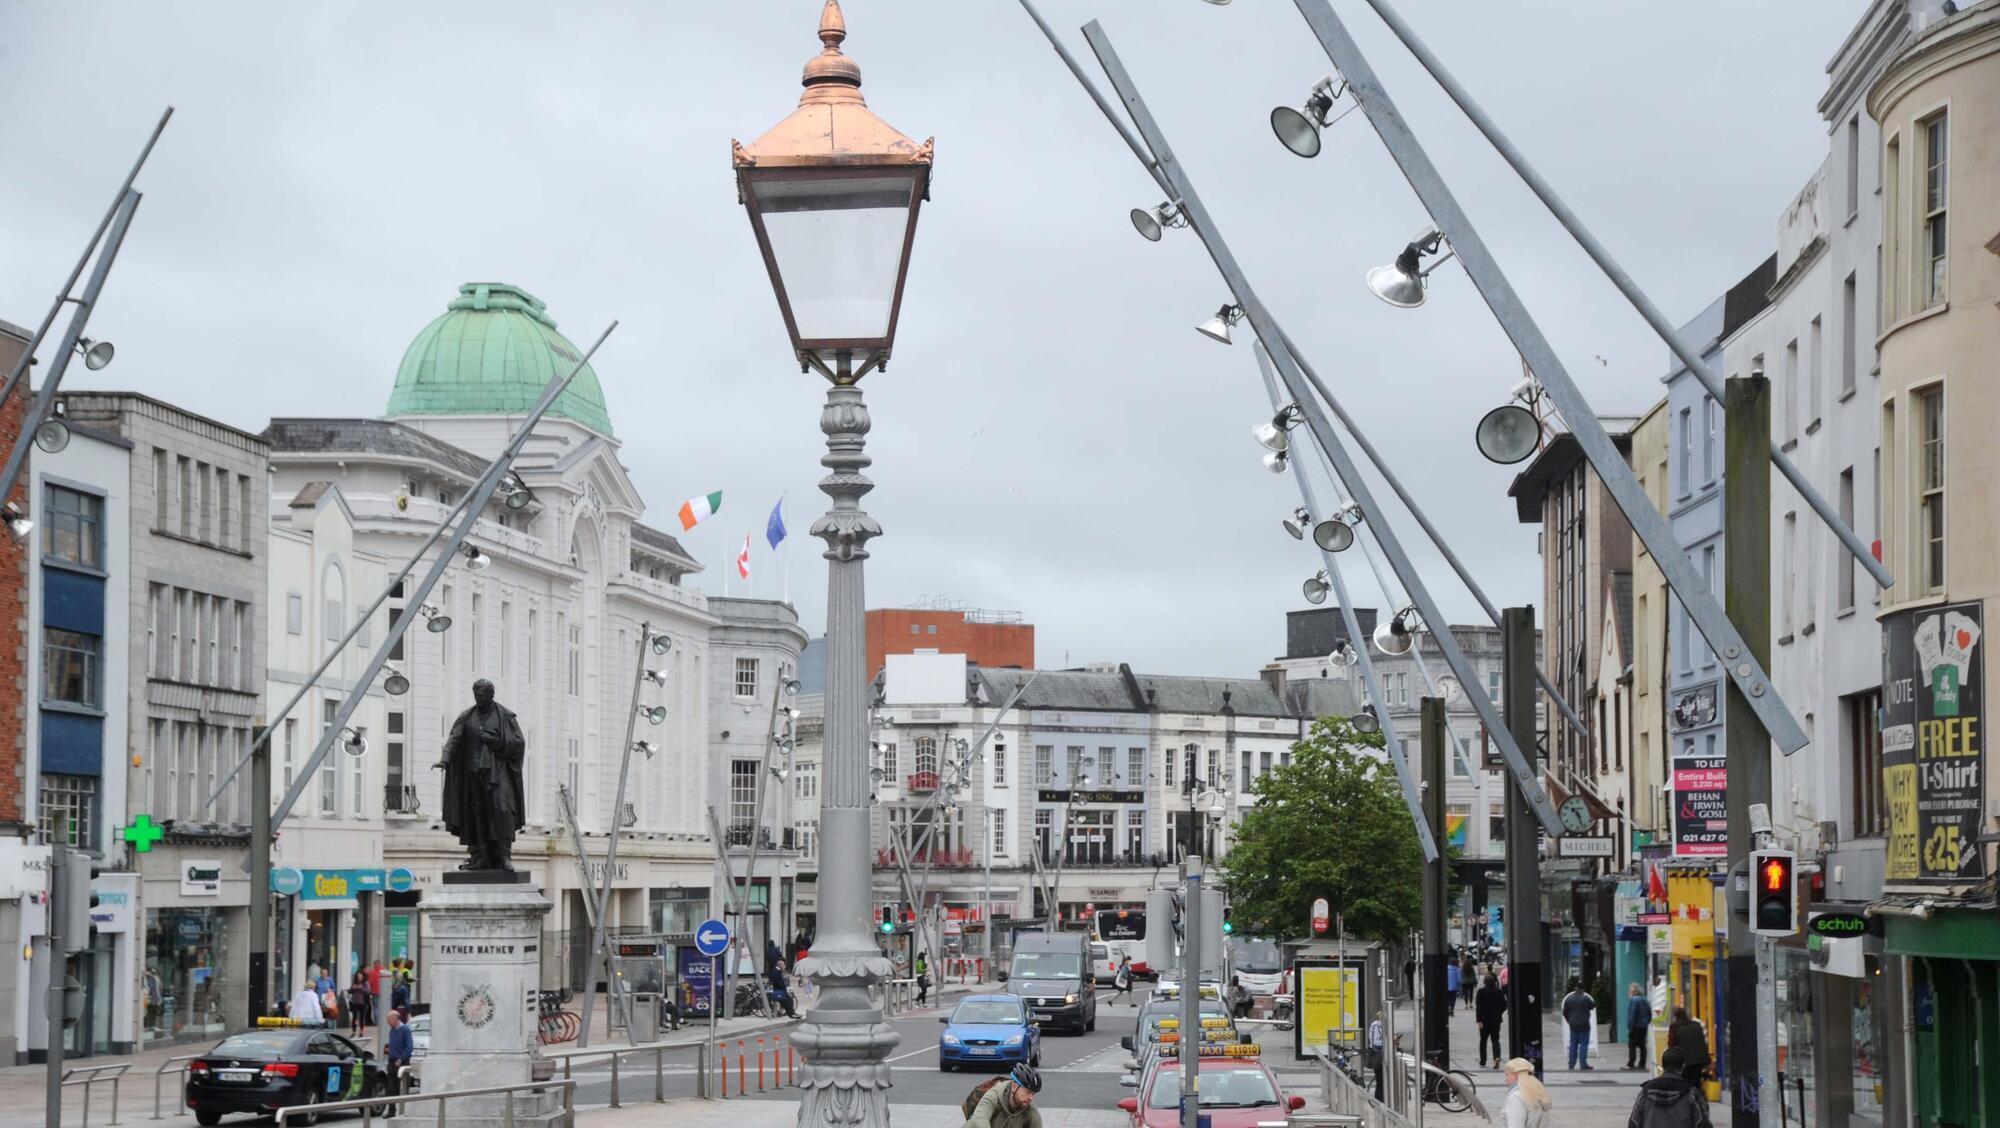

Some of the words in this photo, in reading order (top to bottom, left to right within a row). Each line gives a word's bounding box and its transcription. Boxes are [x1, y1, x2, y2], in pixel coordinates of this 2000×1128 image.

[1919, 717, 1979, 758] FREE
[1695, 760, 1707, 768] TO
[1709, 760, 1725, 768] LET
[1679, 773, 1704, 781] Entire
[1920, 760, 1978, 790] T-Shirt
[1892, 769, 1911, 797] WHY
[1688, 793, 1720, 801] BEHAN
[1694, 802, 1724, 810] IRWIN
[1893, 801, 1909, 829] PAY
[1565, 842, 1607, 851] MICHEL
[1892, 834, 1916, 858] MORE
[1924, 825, 1960, 871] €25
[315, 873, 348, 896] Centra
[1817, 918, 1864, 930] schuh
[441, 945, 474, 954] FATHER
[477, 945, 515, 954] MATHEW
[1200, 1047, 1222, 1055] TAXI
